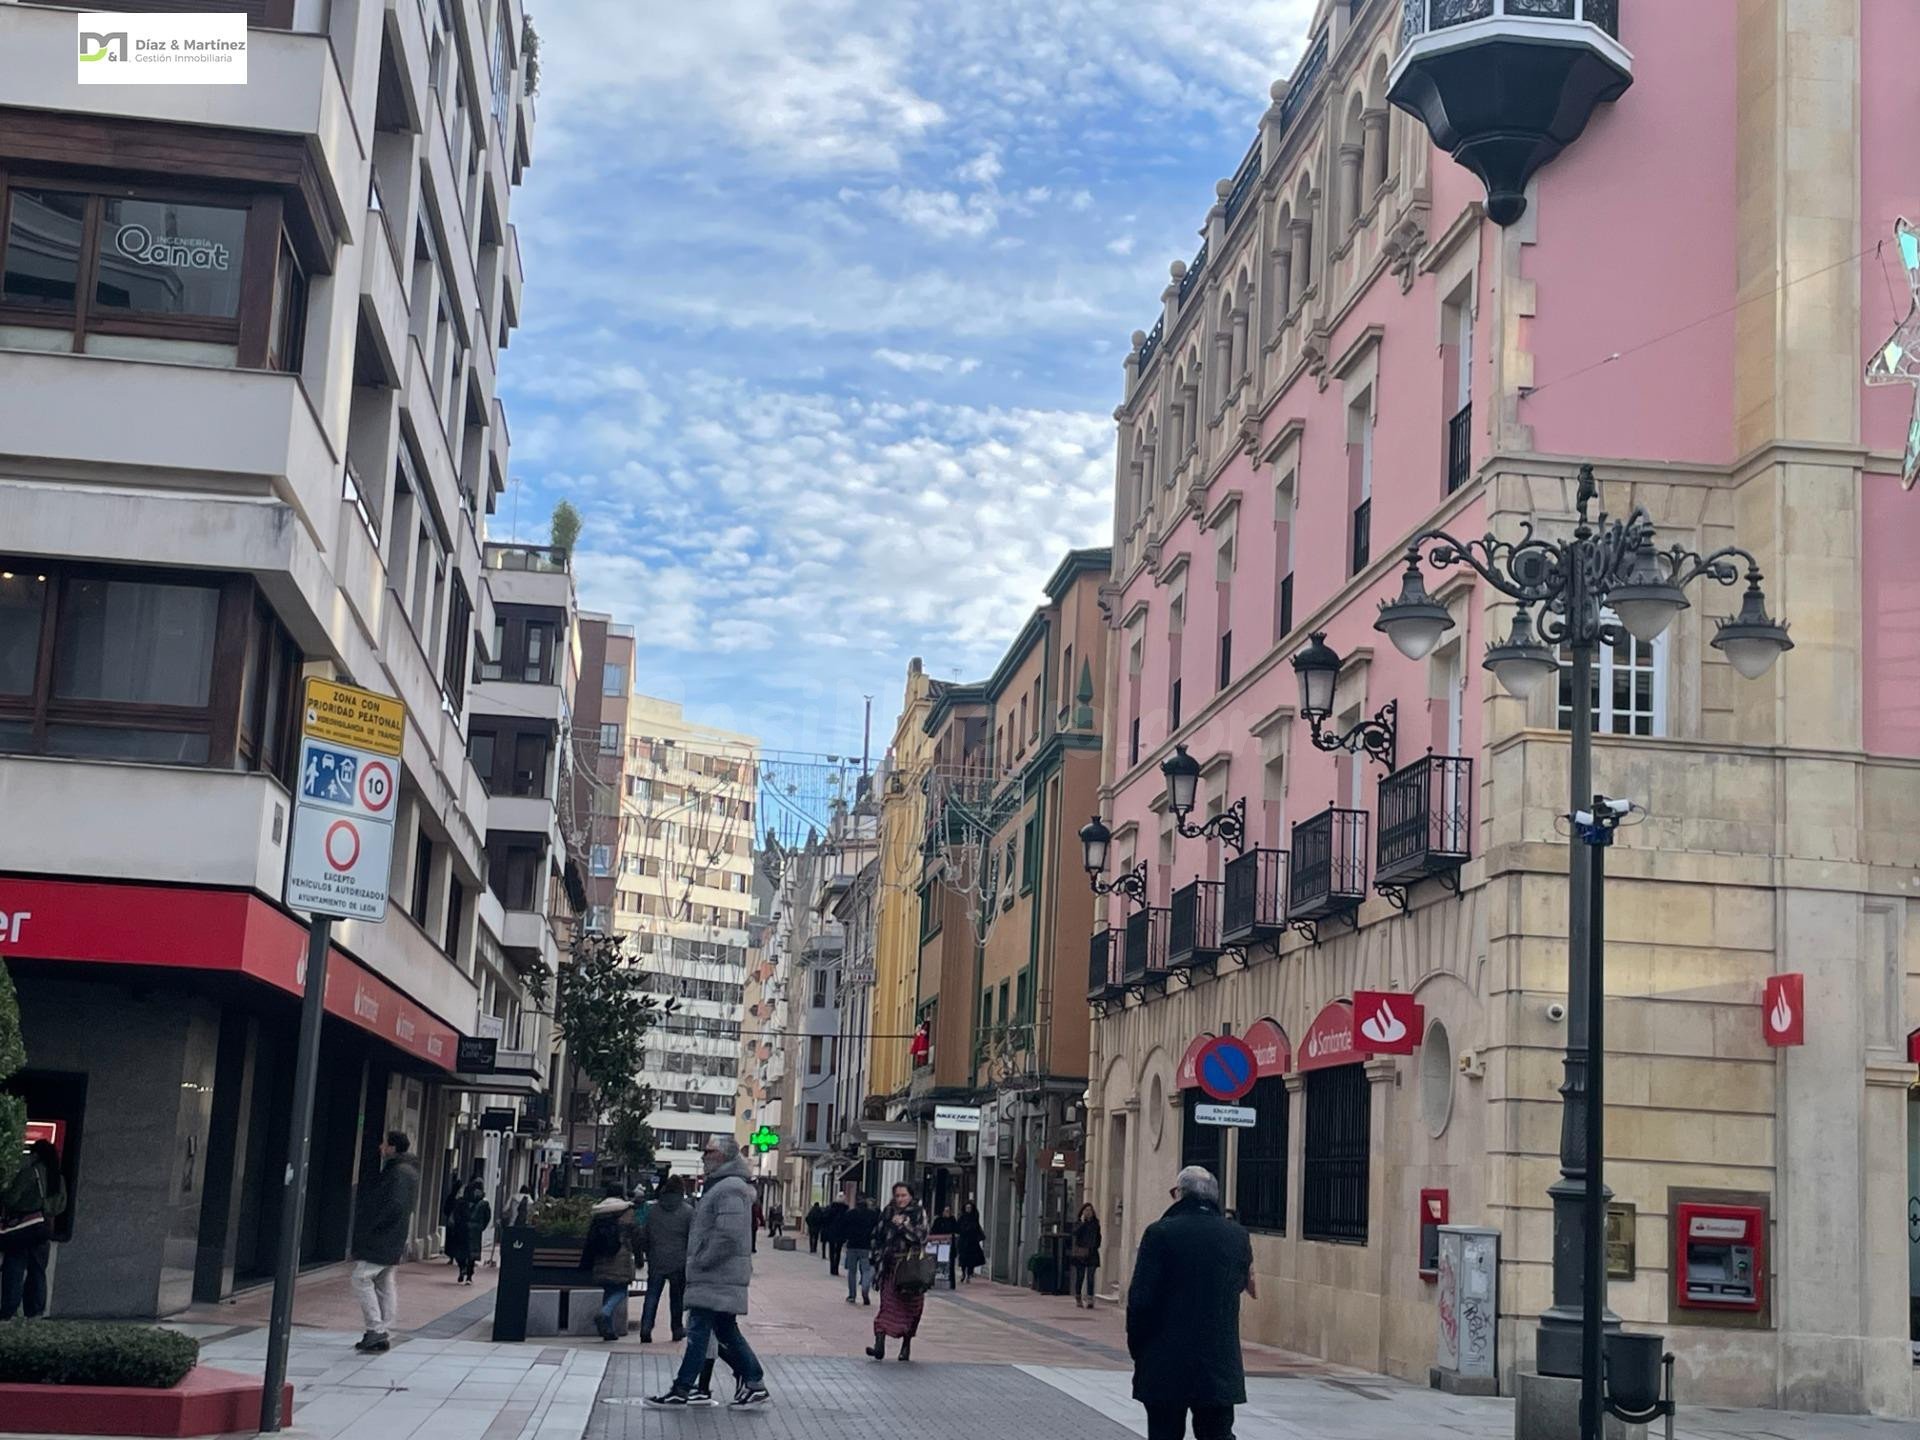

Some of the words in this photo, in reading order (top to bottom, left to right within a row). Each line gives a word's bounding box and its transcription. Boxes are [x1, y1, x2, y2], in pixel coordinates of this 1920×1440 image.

[115, 223, 229, 271] Qanat
[333, 691, 357, 706] ZONA
[361, 699, 380, 712] CON
[307, 698, 355, 718] PRIORIDAD
[358, 710, 401, 731] PEATONAL
[368, 777, 384, 796] 10
[324, 872, 356, 885] EXCEPTO
[298, 894, 347, 909] AYUNTAMIENTO
[349, 902, 357, 910] DE
[335, 886, 384, 901] AUTORIZADOS
[1317, 1025, 1352, 1056] Santande
